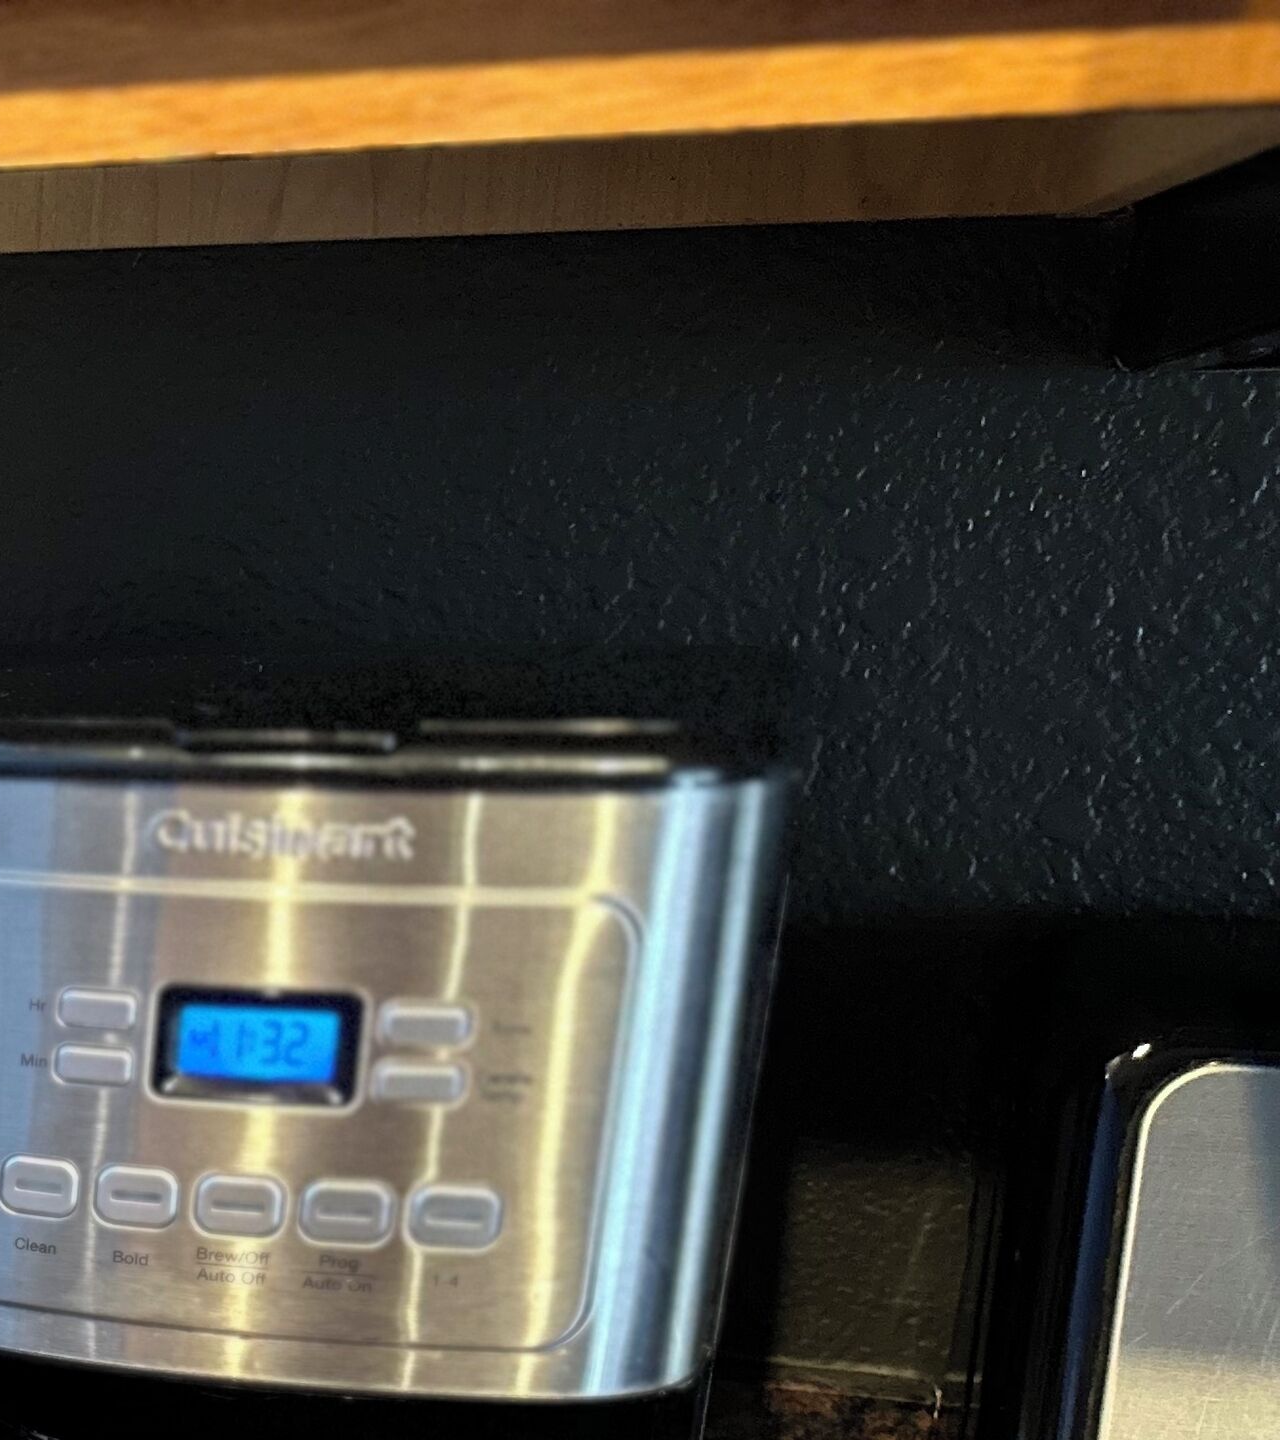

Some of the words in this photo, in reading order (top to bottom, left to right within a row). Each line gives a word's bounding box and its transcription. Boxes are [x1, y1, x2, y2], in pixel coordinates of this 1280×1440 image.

[148, 809, 417, 860] Cuisinart
[20, 1053, 48, 1069] Min
[14, 1236, 57, 1256] Clean
[196, 1246, 270, 1265] Brew/Off
[113, 1250, 149, 1267] Bold
[319, 1254, 360, 1273] Prog
[197, 1267, 235, 1284] Auto
[241, 1269, 266, 1286] Off
[302, 1275, 342, 1292] Auto
[346, 1279, 373, 1294] On
